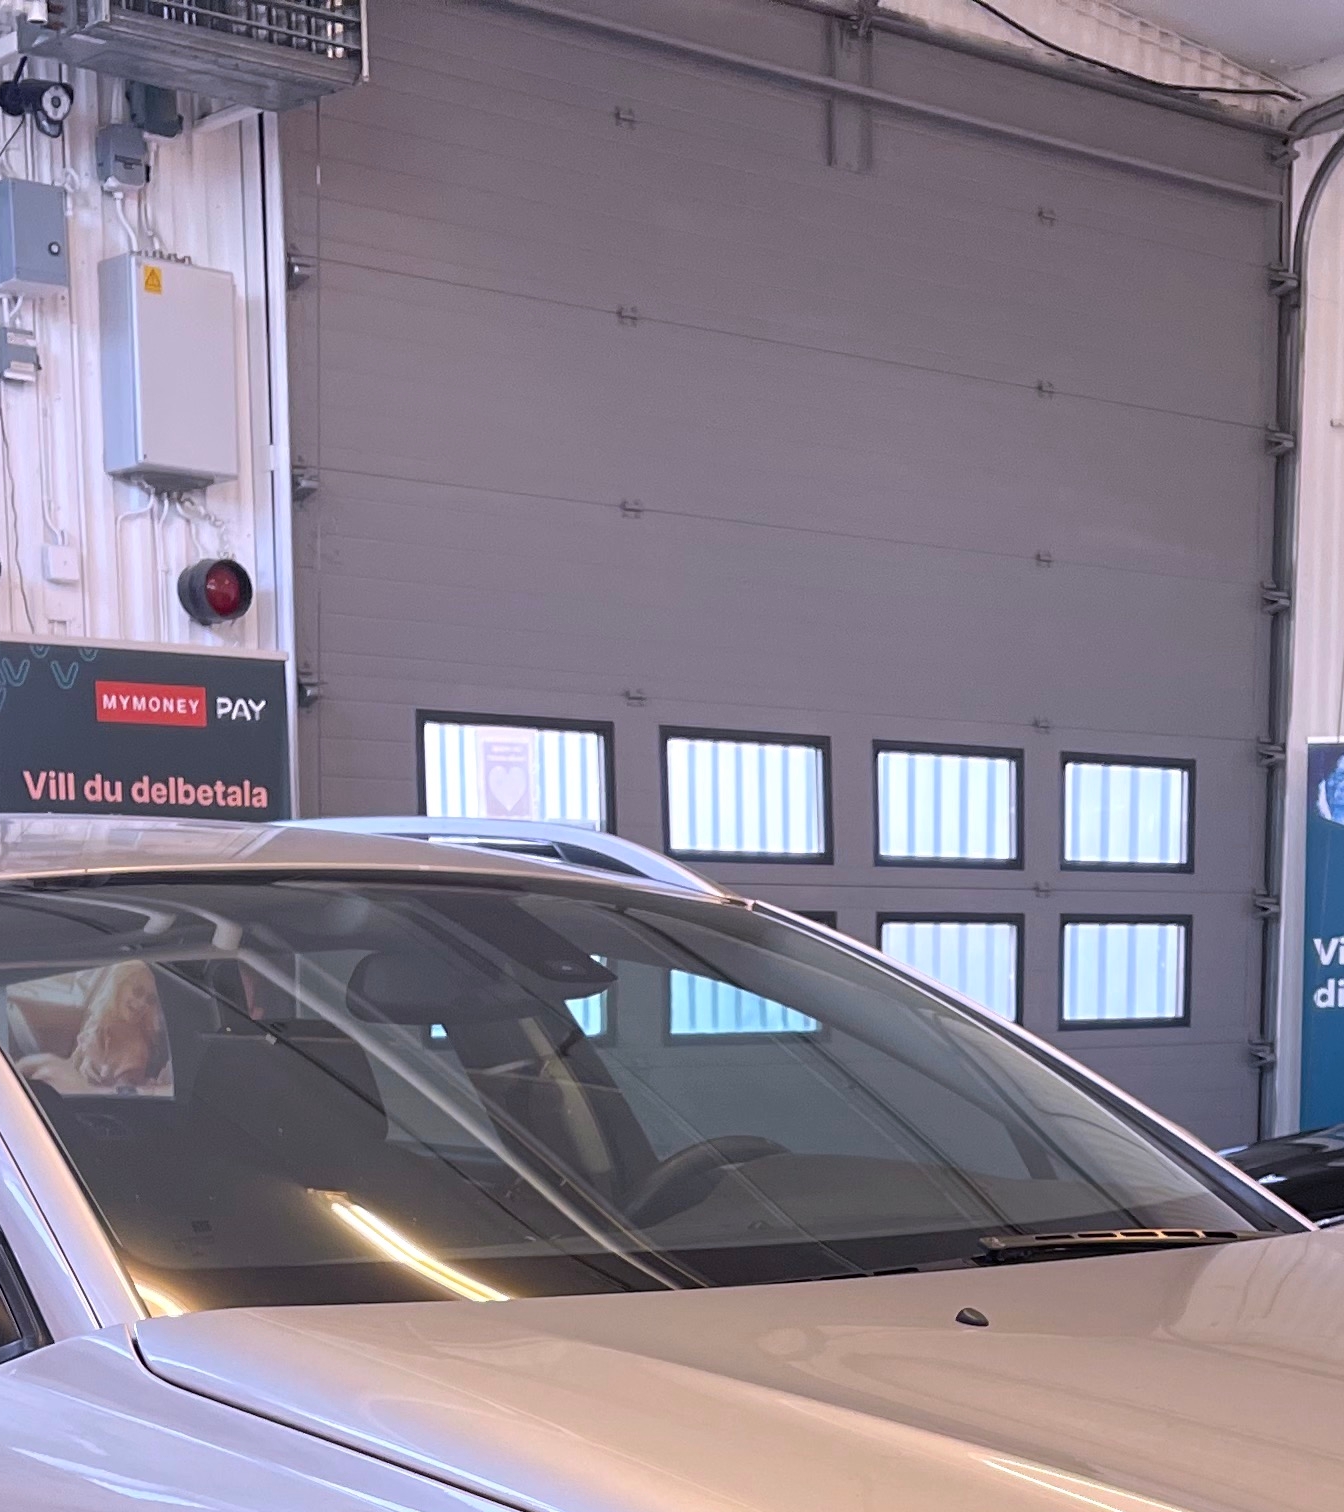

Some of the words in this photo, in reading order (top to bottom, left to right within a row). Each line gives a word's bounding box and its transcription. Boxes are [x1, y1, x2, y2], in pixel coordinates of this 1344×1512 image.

[102, 694, 200, 715] MYMONEY
[215, 696, 267, 722] PAY
[22, 770, 76, 801] Vill
[83, 773, 123, 803] du
[130, 775, 269, 809] delbetala
